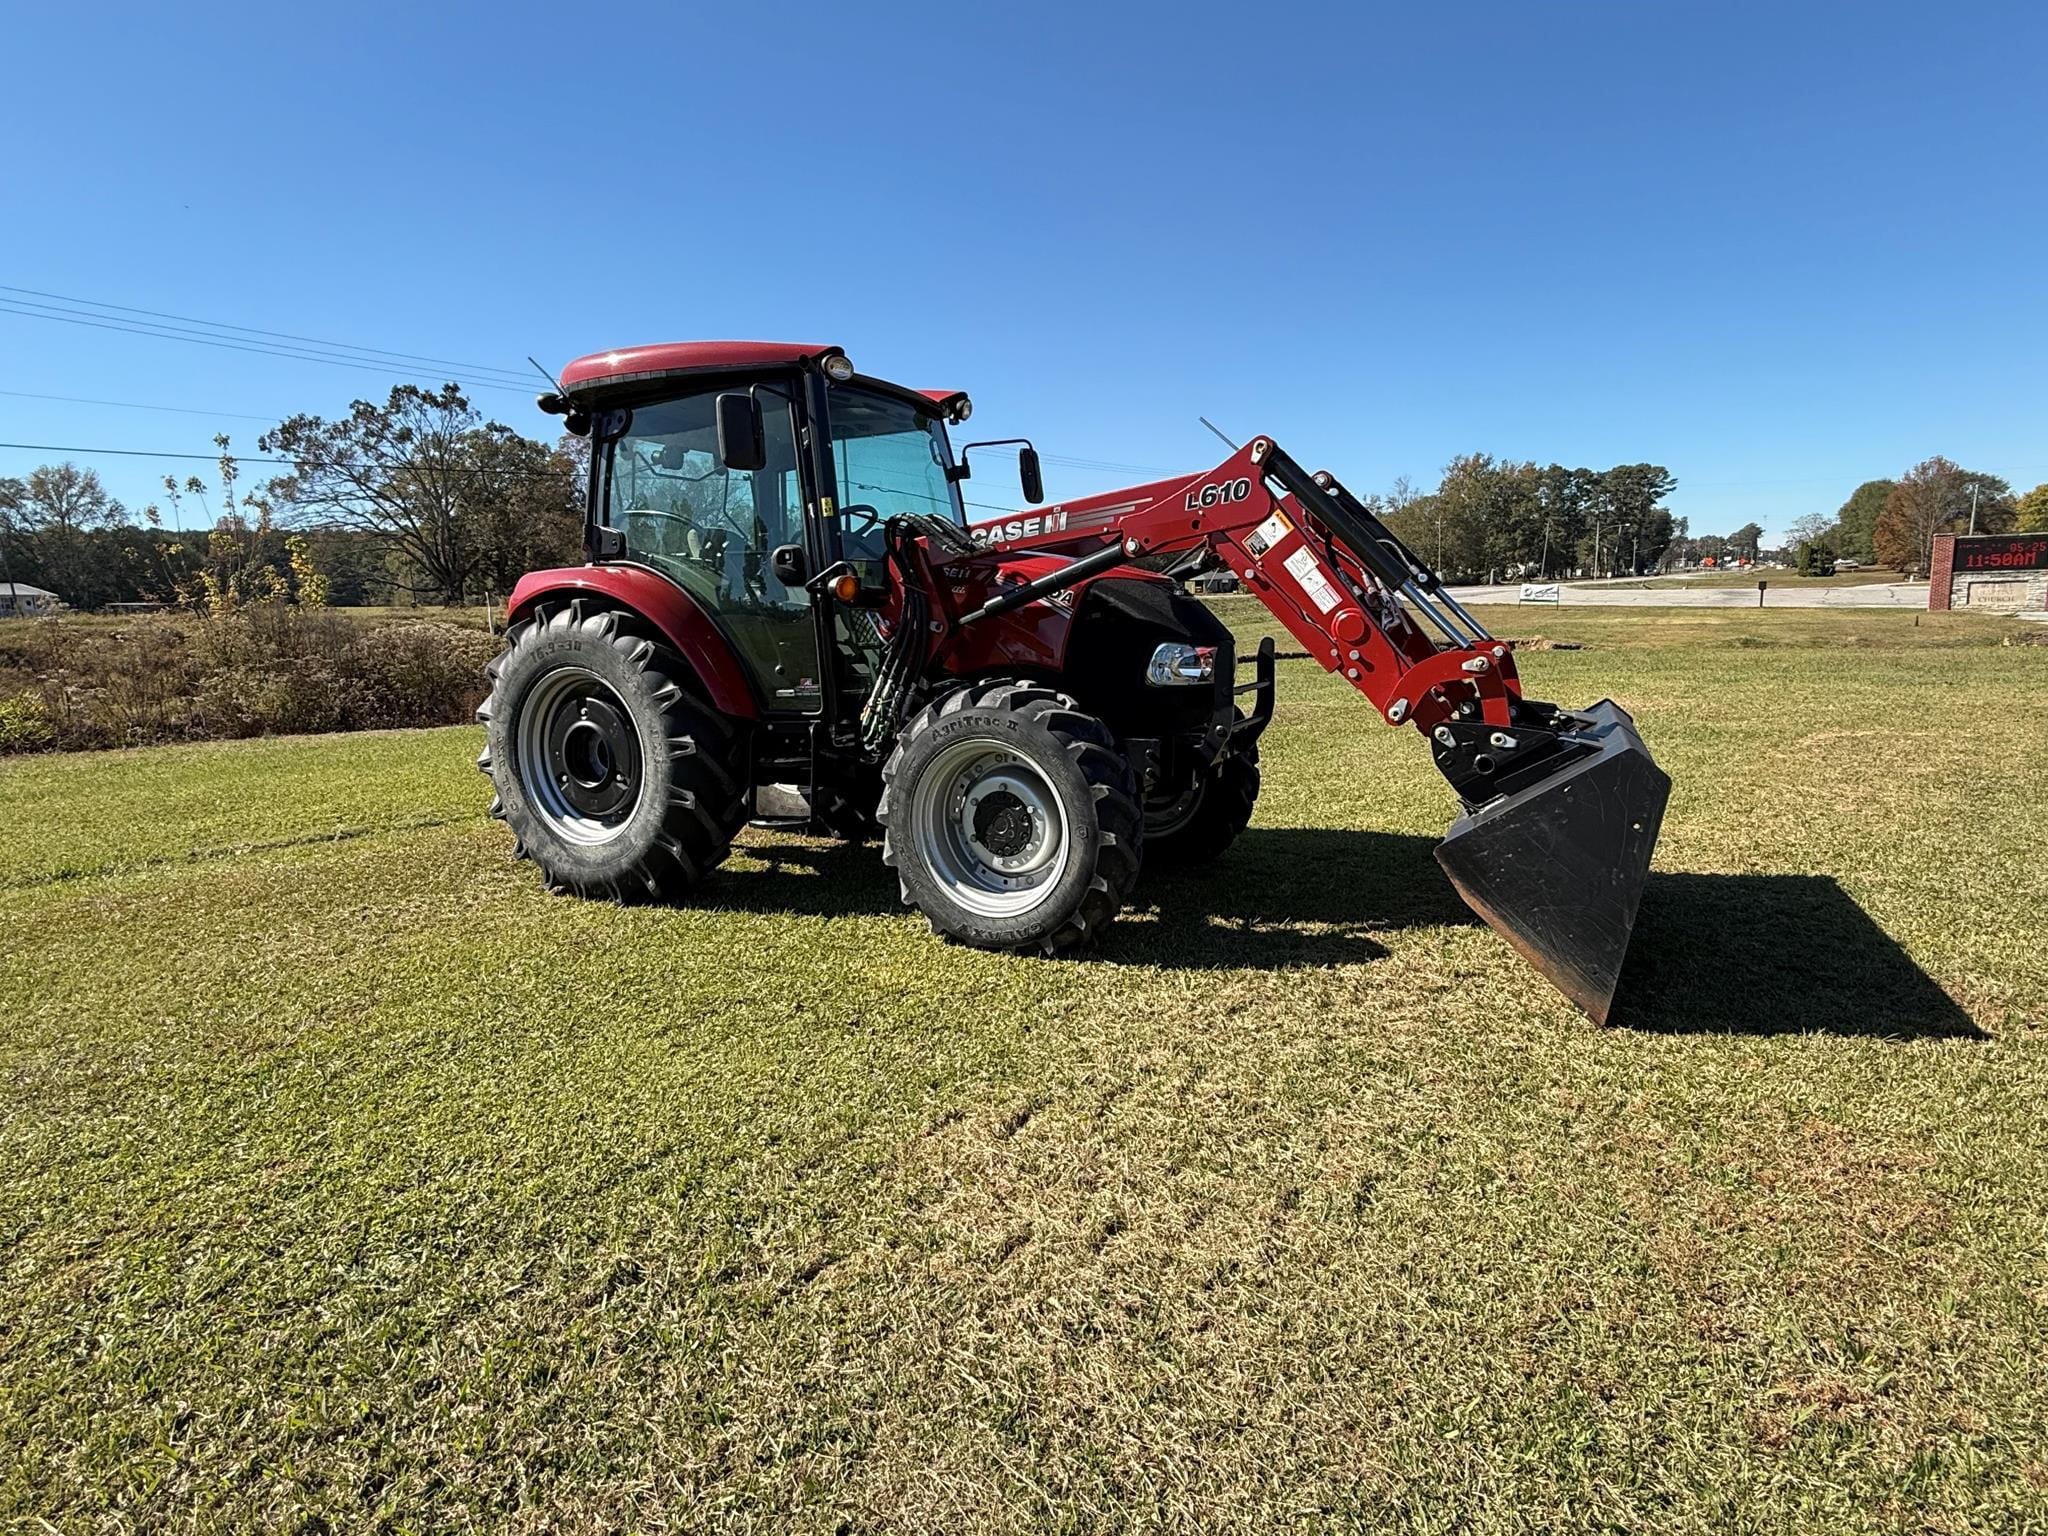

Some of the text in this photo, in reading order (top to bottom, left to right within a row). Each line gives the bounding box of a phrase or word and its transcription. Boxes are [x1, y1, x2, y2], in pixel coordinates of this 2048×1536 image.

[1185, 477, 1252, 511] L610
[970, 517, 1041, 546] CASE
[1966, 551, 2037, 568] 11:50AM
[530, 640, 582, 663] 16.9-30
[932, 716, 1001, 742] AgriTrac
